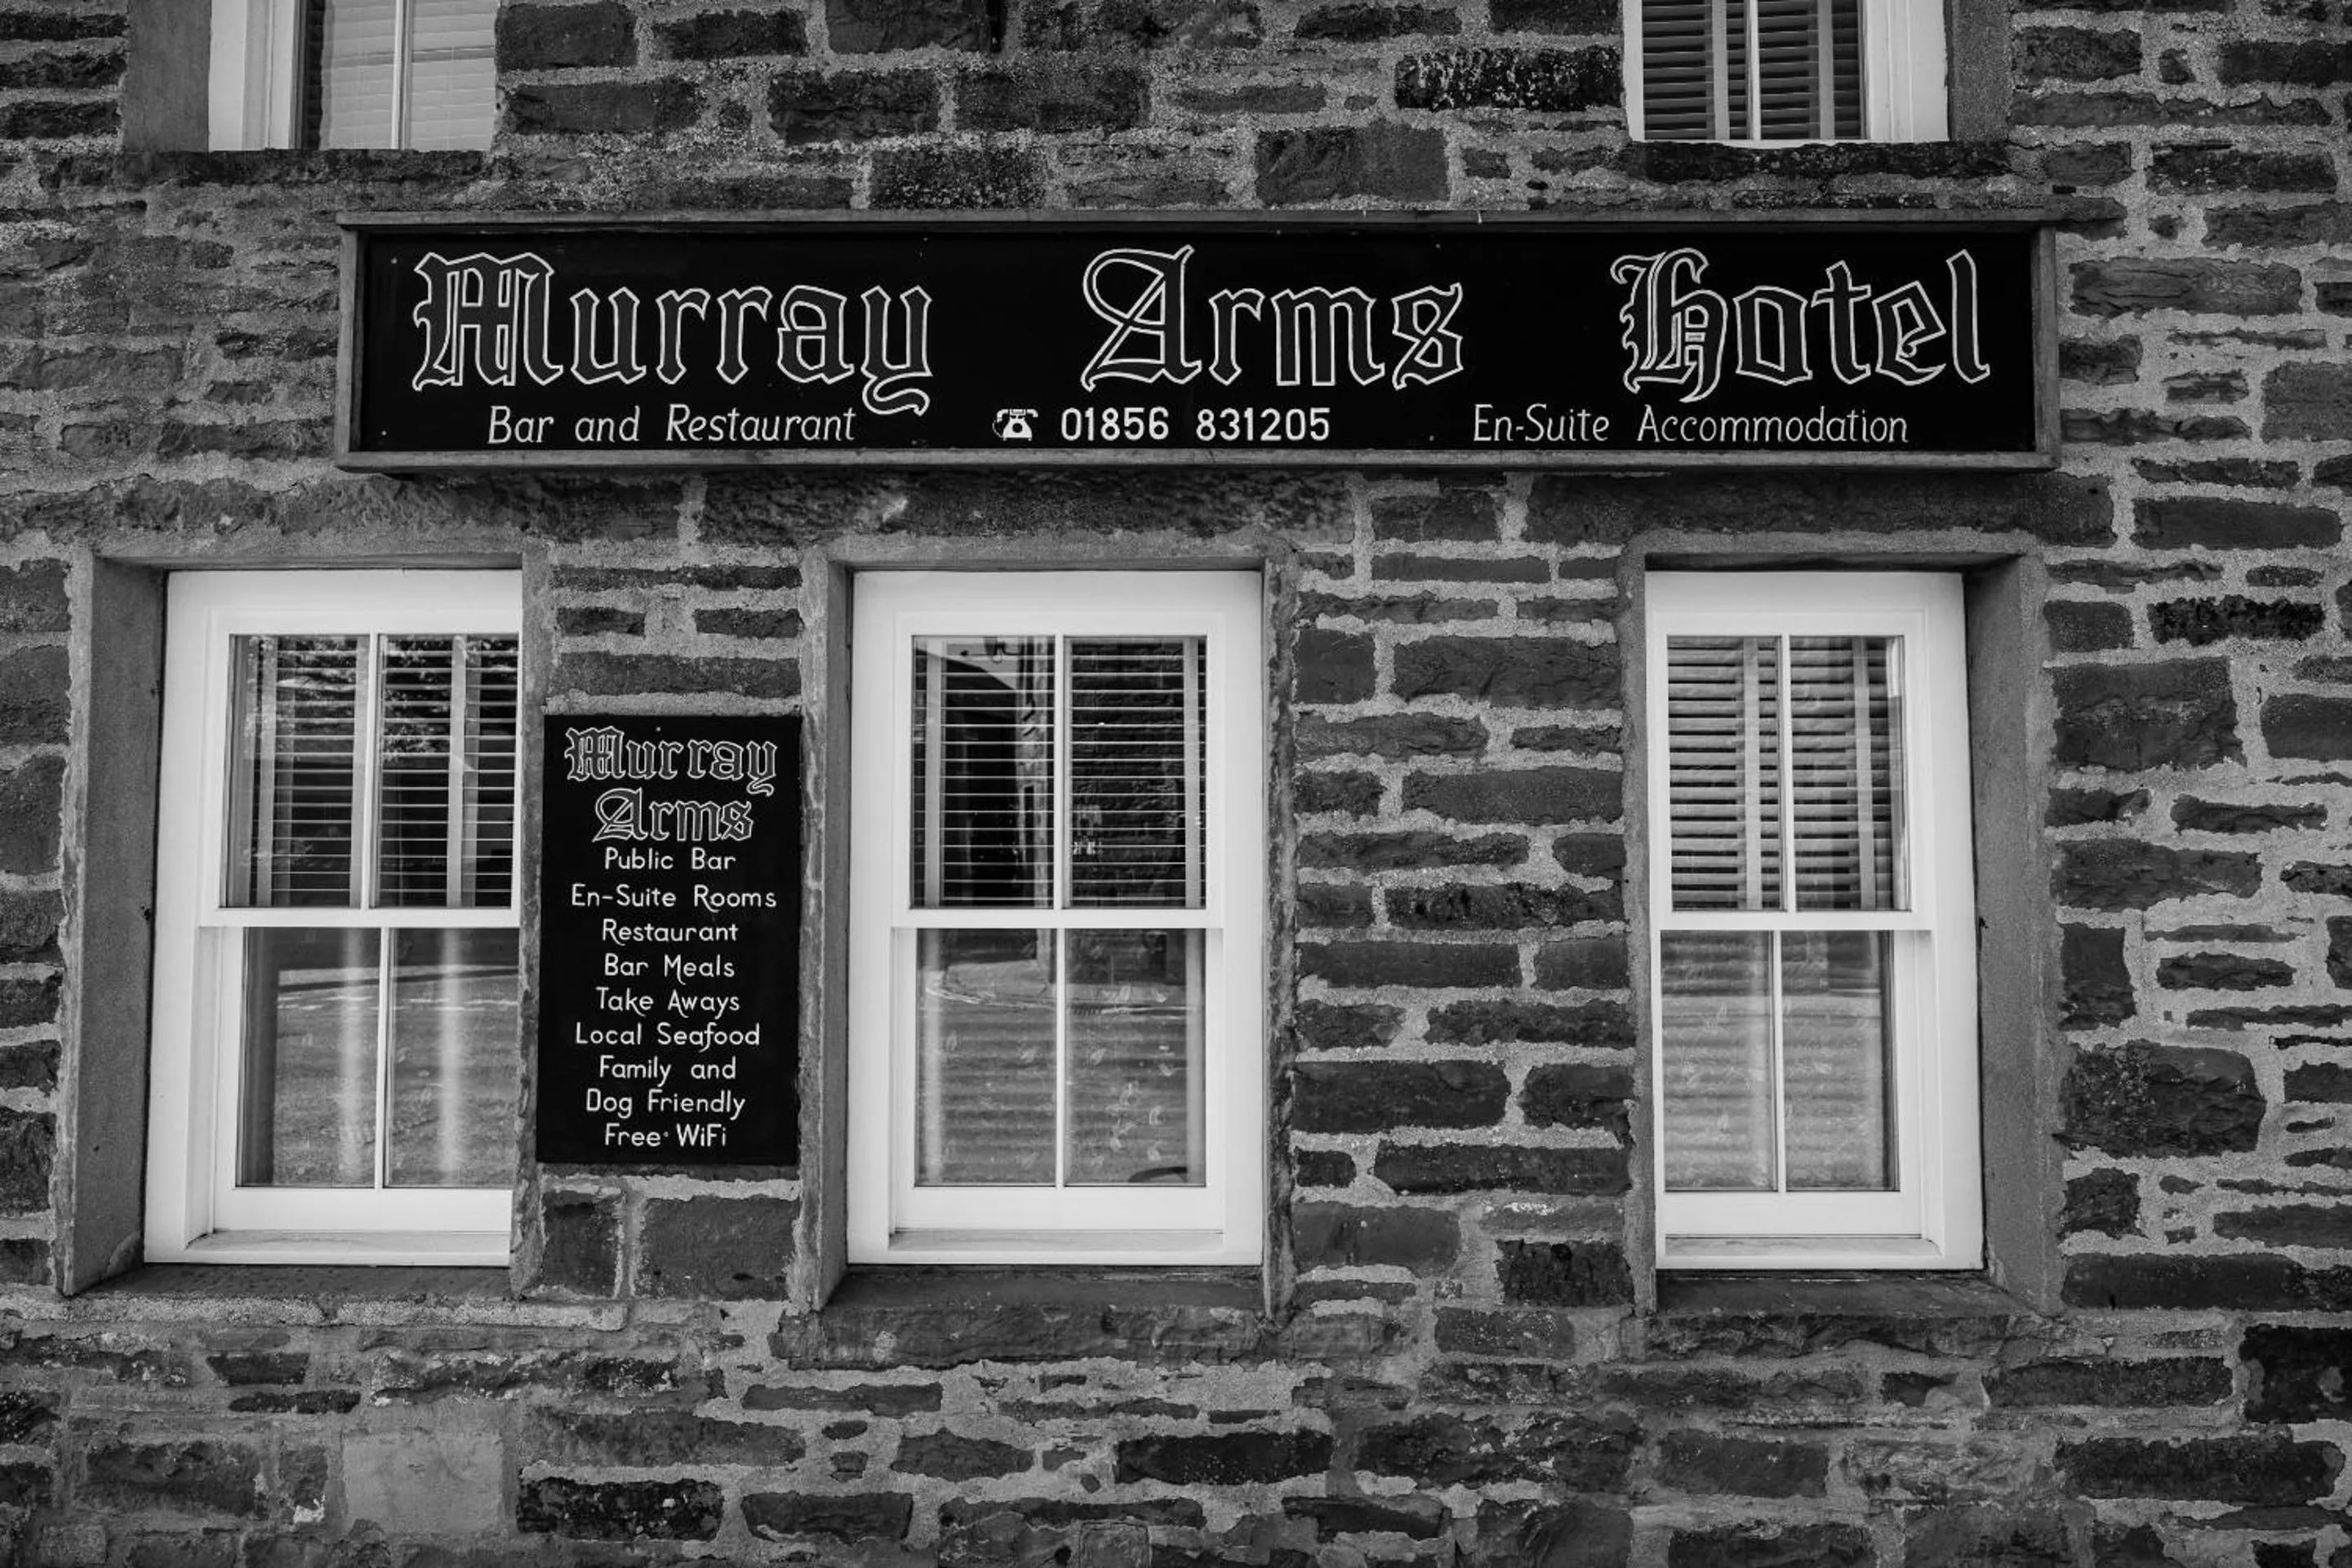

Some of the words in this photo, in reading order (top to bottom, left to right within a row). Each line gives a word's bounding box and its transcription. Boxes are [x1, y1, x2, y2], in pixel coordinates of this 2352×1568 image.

[411, 251, 934, 416] Murray
[1080, 244, 1464, 392] Arms
[1609, 247, 1991, 403] Hotel
[487, 405, 555, 445] Bar
[574, 405, 641, 443] and
[665, 403, 857, 443] Restaurant
[1060, 406, 1170, 442] 01856
[1195, 406, 1331, 442] 831205
[1472, 403, 1611, 442] En-Suite
[1636, 404, 1909, 443] Accommodation
[563, 725, 778, 797] Murray
[591, 787, 754, 843] Arms
[603, 846, 674, 870] Public
[691, 846, 736, 870] Bar
[571, 882, 677, 908] En-Suite
[692, 884, 778, 913] Rooms
[602, 917, 739, 946] Restaurant
[603, 953, 649, 977] Bar
[664, 954, 736, 985] Meals
[594, 986, 655, 1018] Take
[666, 988, 740, 1020] Aways
[575, 1021, 642, 1046] Local
[656, 1022, 761, 1053] Seafood
[598, 1055, 672, 1088] Family
[690, 1055, 737, 1080] and
[585, 1087, 634, 1119] Dog
[647, 1089, 747, 1122] Friendly
[604, 1122, 661, 1147] Free
[675, 1123, 727, 1147] WiFi
